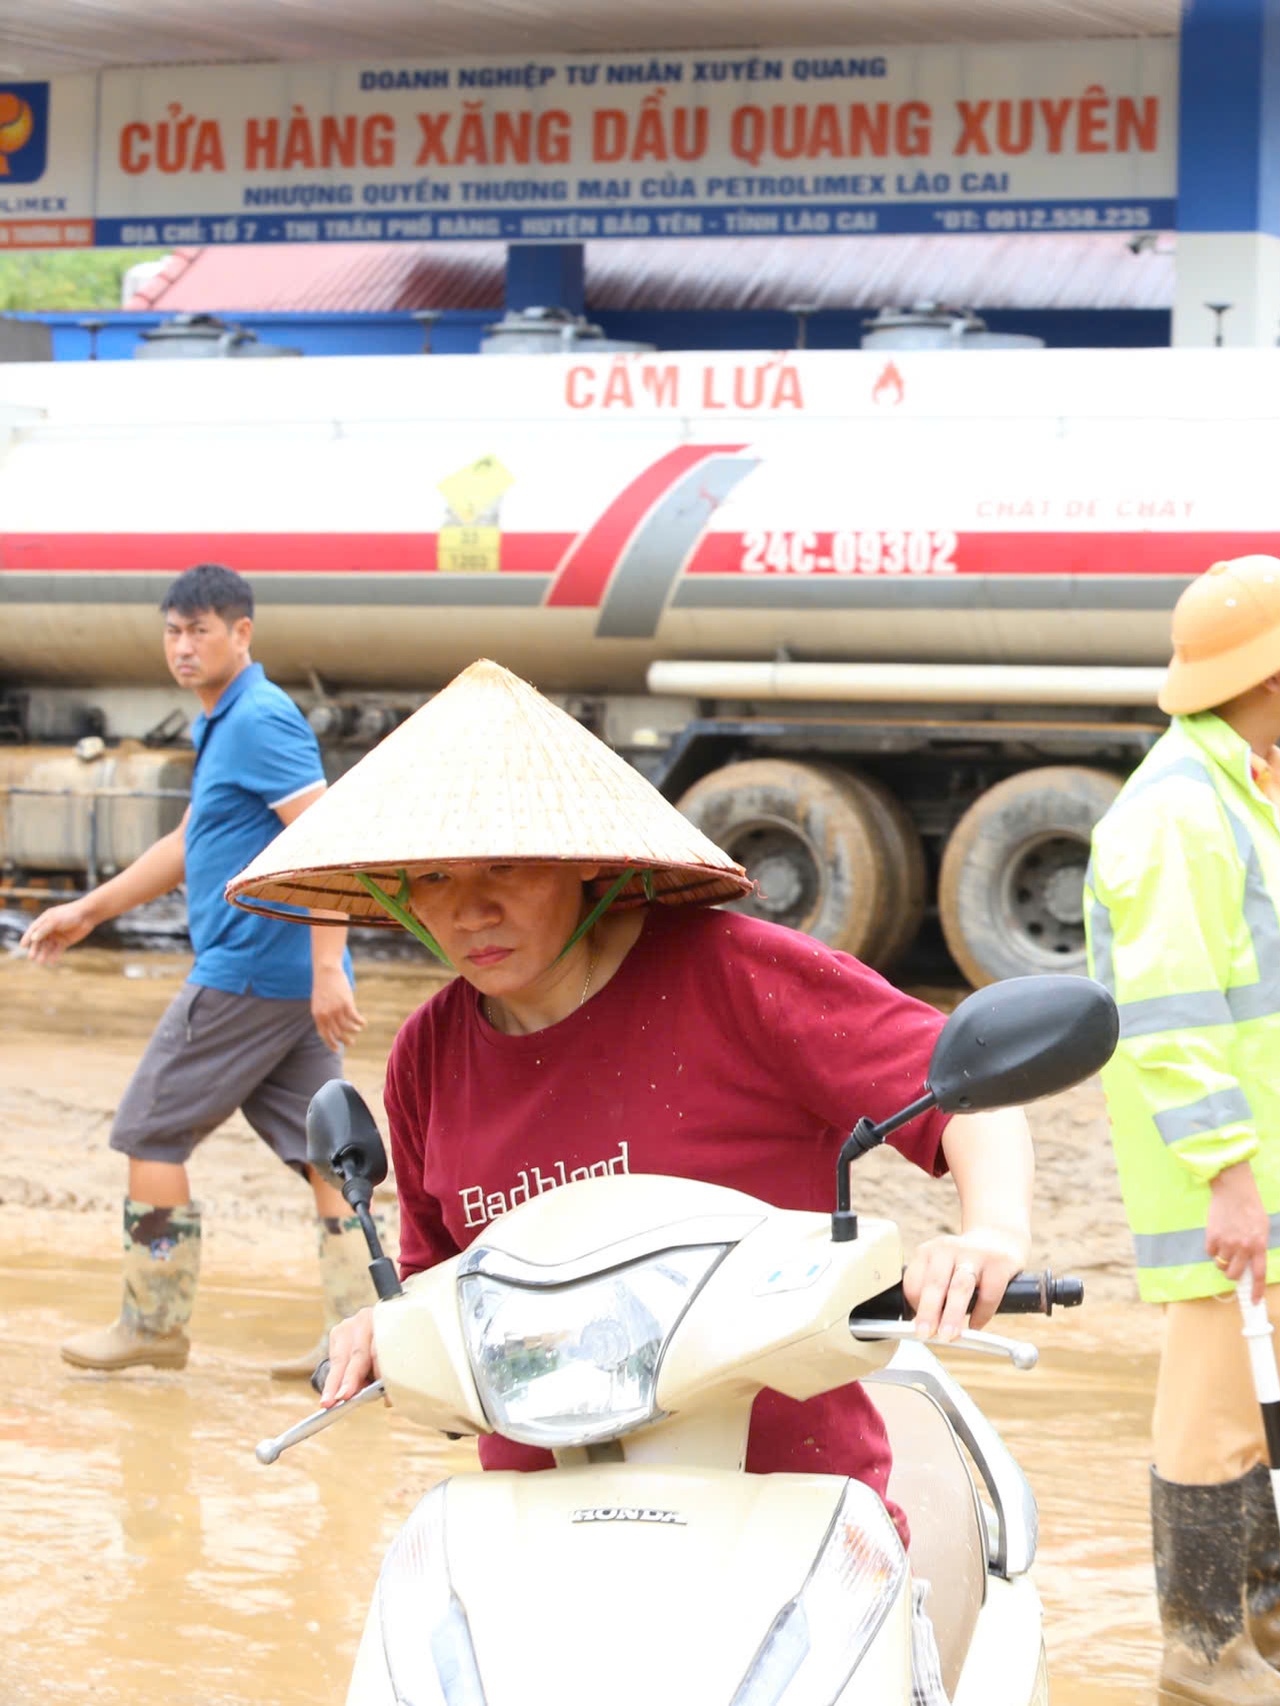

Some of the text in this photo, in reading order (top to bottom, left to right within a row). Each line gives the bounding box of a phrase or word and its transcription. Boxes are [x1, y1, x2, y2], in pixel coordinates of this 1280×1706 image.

[360, 56, 887, 91] DOANH NGHIỆP TƯ NHÂN XUYÊN QUANG
[118, 102, 226, 175] CỬA
[244, 105, 396, 171] HÀNG
[415, 100, 572, 167] XĂNG
[730, 101, 932, 167] QUANG
[953, 85, 1158, 156] XUYÊN
[706, 173, 886, 198] PETROLIMEX
[896, 170, 951, 195] LÀO
[960, 171, 1009, 194] CAI
[0, 197, 67, 213] LIMEX
[243, 222, 258, 241] 7
[835, 210, 878, 231] CAI
[564, 350, 679, 409] CẤM
[741, 530, 958, 574] 24C-09302
[571, 1506, 689, 1526] HONDA
